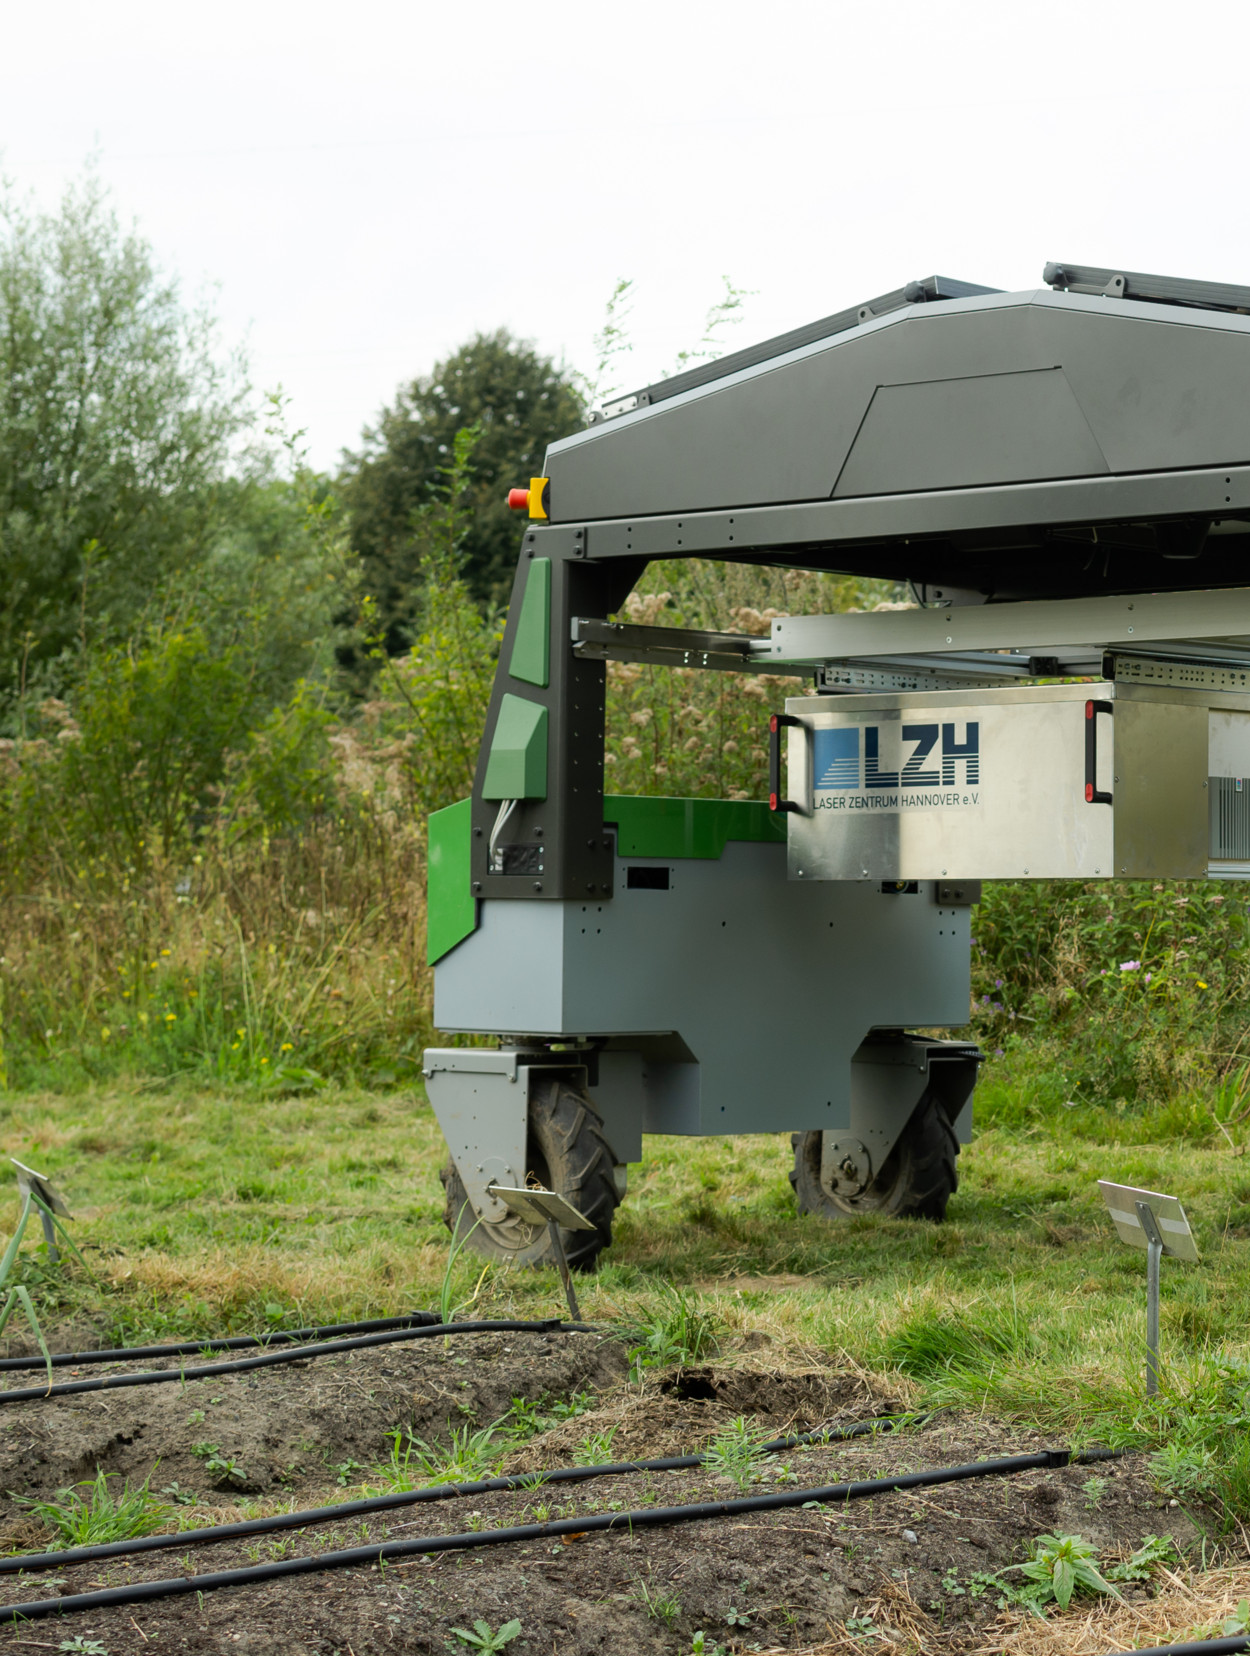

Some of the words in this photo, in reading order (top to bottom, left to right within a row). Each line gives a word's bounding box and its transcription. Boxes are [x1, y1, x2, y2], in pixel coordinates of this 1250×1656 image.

[865, 722, 979, 788] LZH
[813, 796, 846, 810] LASER
[849, 795, 898, 809] ZENTRUM
[901, 793, 960, 807] HANNOVER
[962, 793, 980, 805] e.V.
